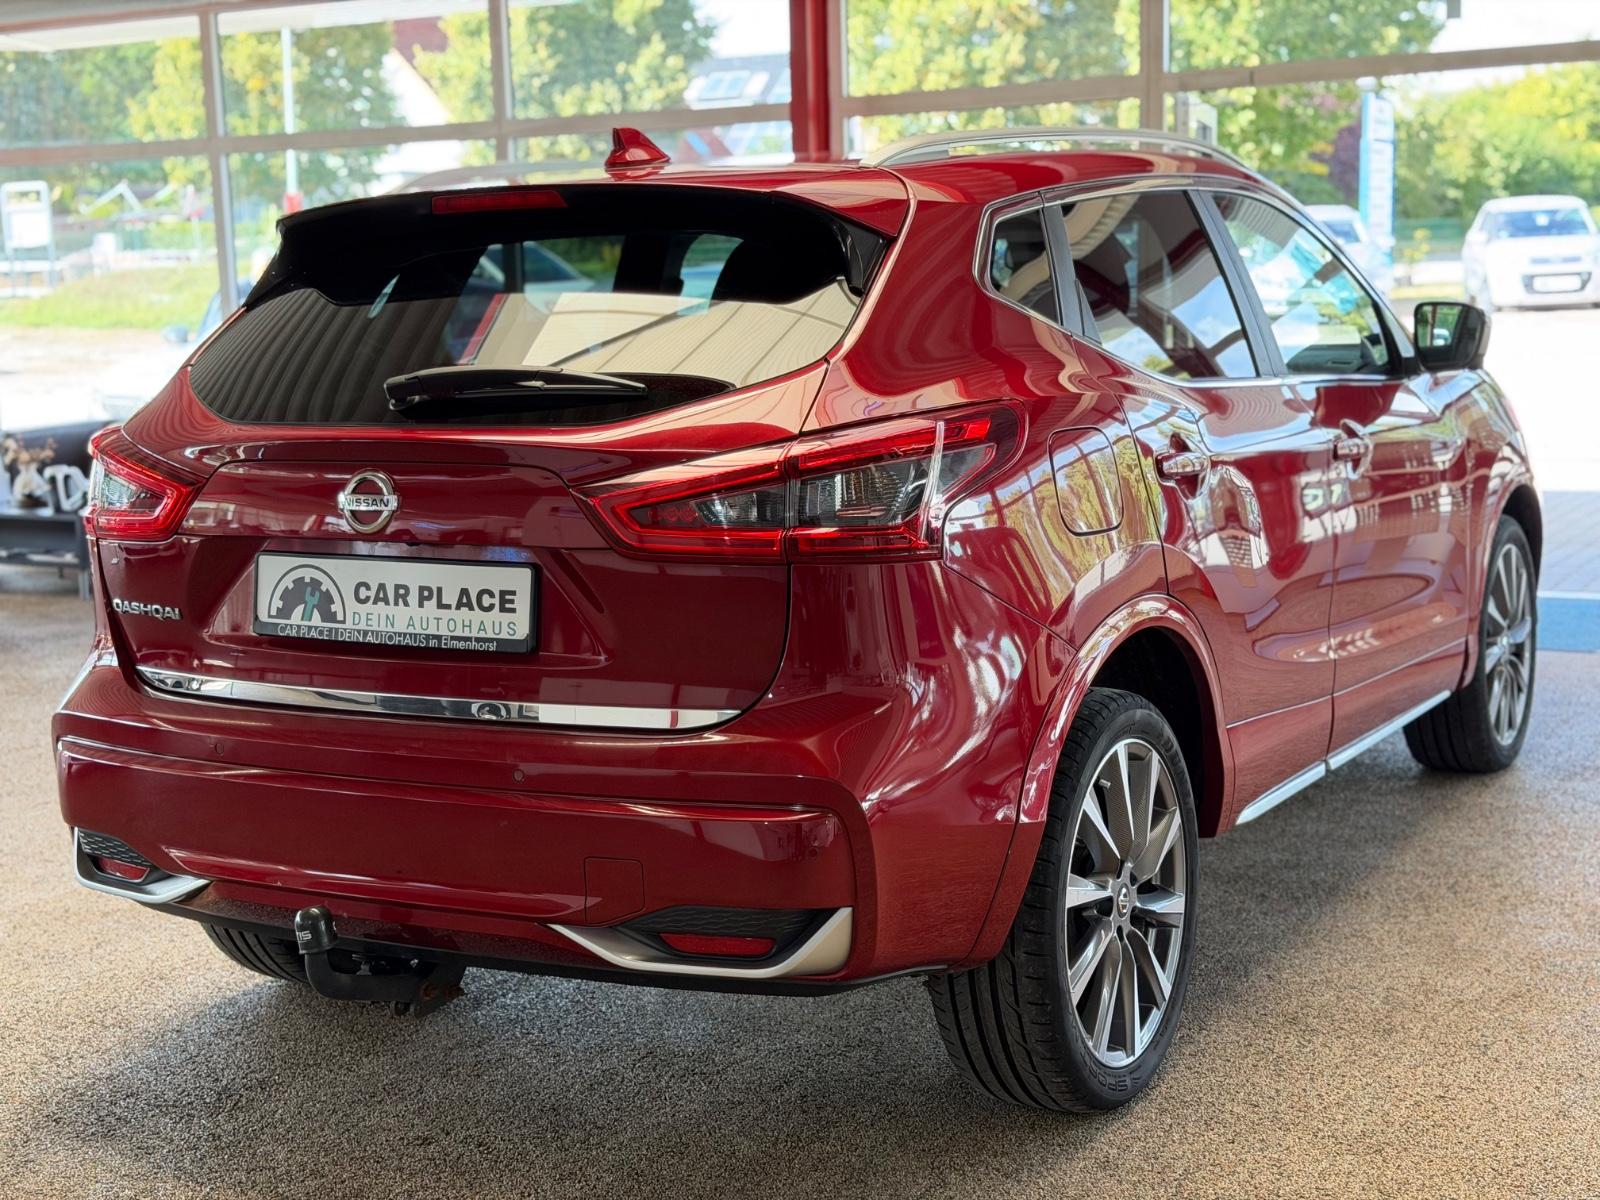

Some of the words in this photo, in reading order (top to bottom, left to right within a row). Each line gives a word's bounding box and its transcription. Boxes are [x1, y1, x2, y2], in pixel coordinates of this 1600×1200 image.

[345, 496, 390, 508] NISSAN
[112, 598, 181, 621] QASHQAI
[353, 581, 411, 607] CAR
[418, 585, 517, 614] PLACE
[352, 611, 395, 629] DEIN
[406, 615, 517, 637] AUTOHAUS
[277, 624, 298, 637] CAR
[300, 625, 330, 640] PLACE
[338, 629, 363, 643] DEIN
[365, 631, 426, 647] AUTOHAUS
[429, 636, 438, 647] in
[441, 636, 497, 652] Elmenhorst
